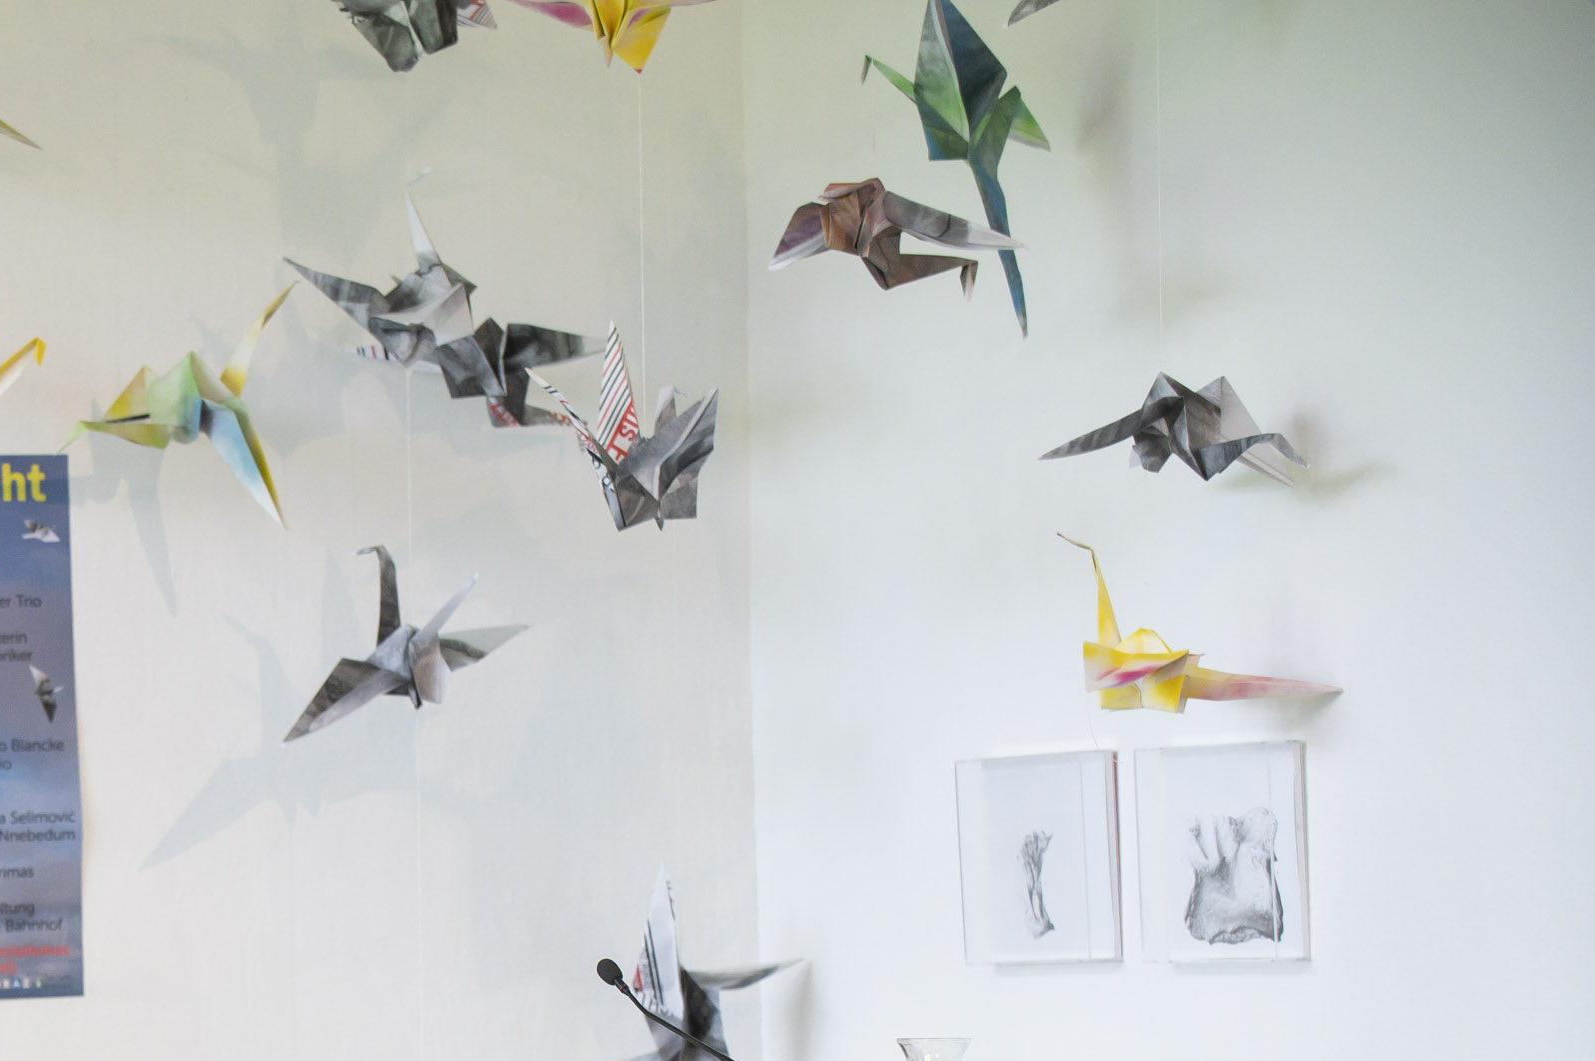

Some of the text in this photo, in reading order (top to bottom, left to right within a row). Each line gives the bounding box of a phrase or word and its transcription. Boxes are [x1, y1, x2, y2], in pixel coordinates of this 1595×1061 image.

[15, 593, 42, 608] Trio
[11, 738, 65, 753] Blancke
[5, 917, 63, 933] Bahnhof
